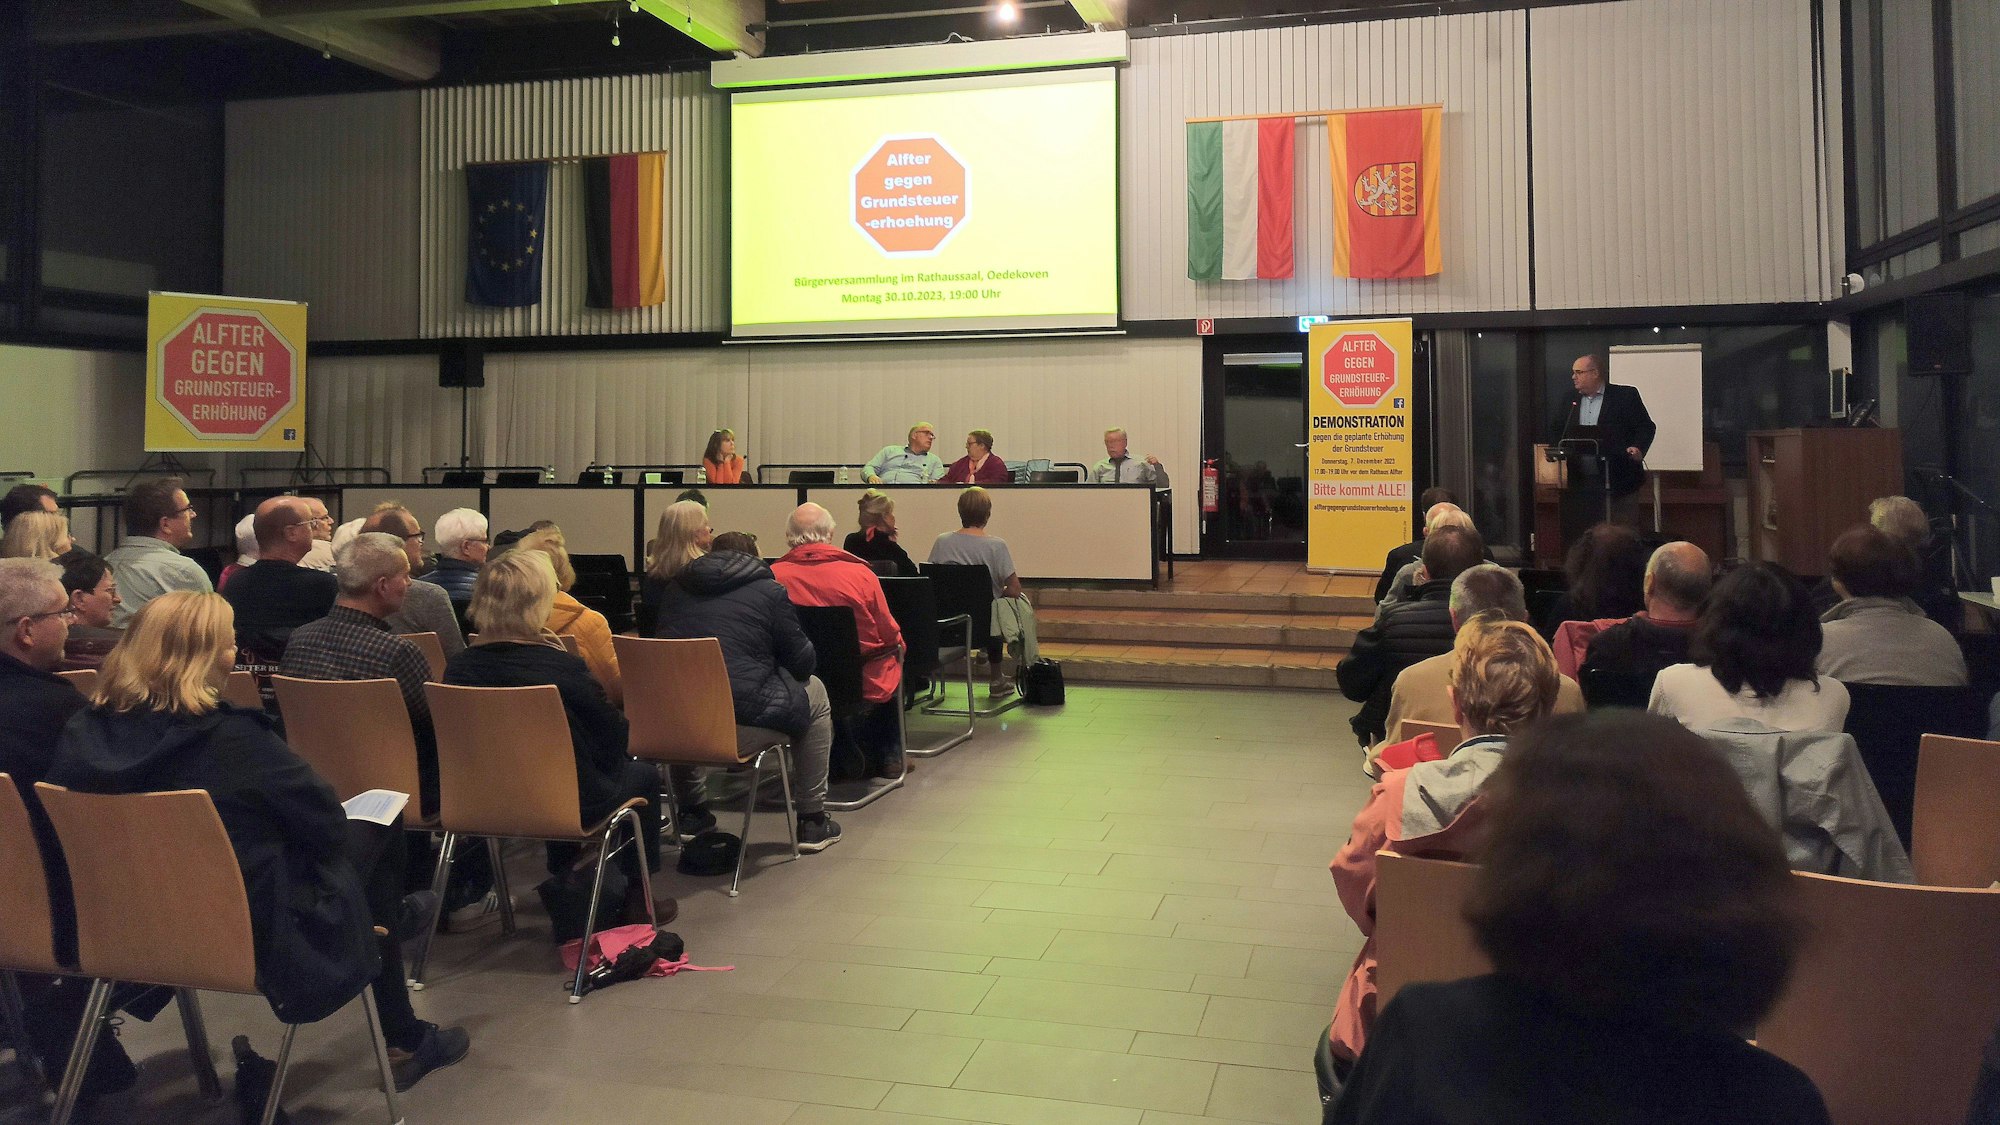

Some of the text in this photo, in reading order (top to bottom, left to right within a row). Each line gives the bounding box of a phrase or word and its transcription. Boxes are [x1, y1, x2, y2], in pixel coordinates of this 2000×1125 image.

[887, 152, 931, 166] Alfter
[884, 174, 932, 189] gegen
[860, 193, 959, 209] Grundsteuer
[865, 215, 954, 229] -erhoehung
[794, 269, 1049, 289] Bürgerversammlung im Rathaussaal, Oedekoven
[842, 289, 1002, 305] Montag 30.10.2023, 19:00 Uhr
[192, 323, 265, 347] ALFTER
[1342, 340, 1376, 352] ALFTER
[191, 350, 264, 376] GEGEN
[1344, 357, 1374, 368] GEGEN
[1329, 373, 1390, 383] GRUNDSTEUER-
[174, 379, 282, 398] GRUNDSTEUER-
[1339, 386, 1381, 398] ERHÖHUNG
[192, 402, 267, 421] ERHÖHUNG
[1313, 415, 1404, 428] DEMONSTRATION
[1313, 432, 1404, 442] gegen die geplante Erhöhung
[1332, 444, 1384, 453] der Grundsteuer
[1313, 483, 1406, 497] Bitte kommt ALLE!
